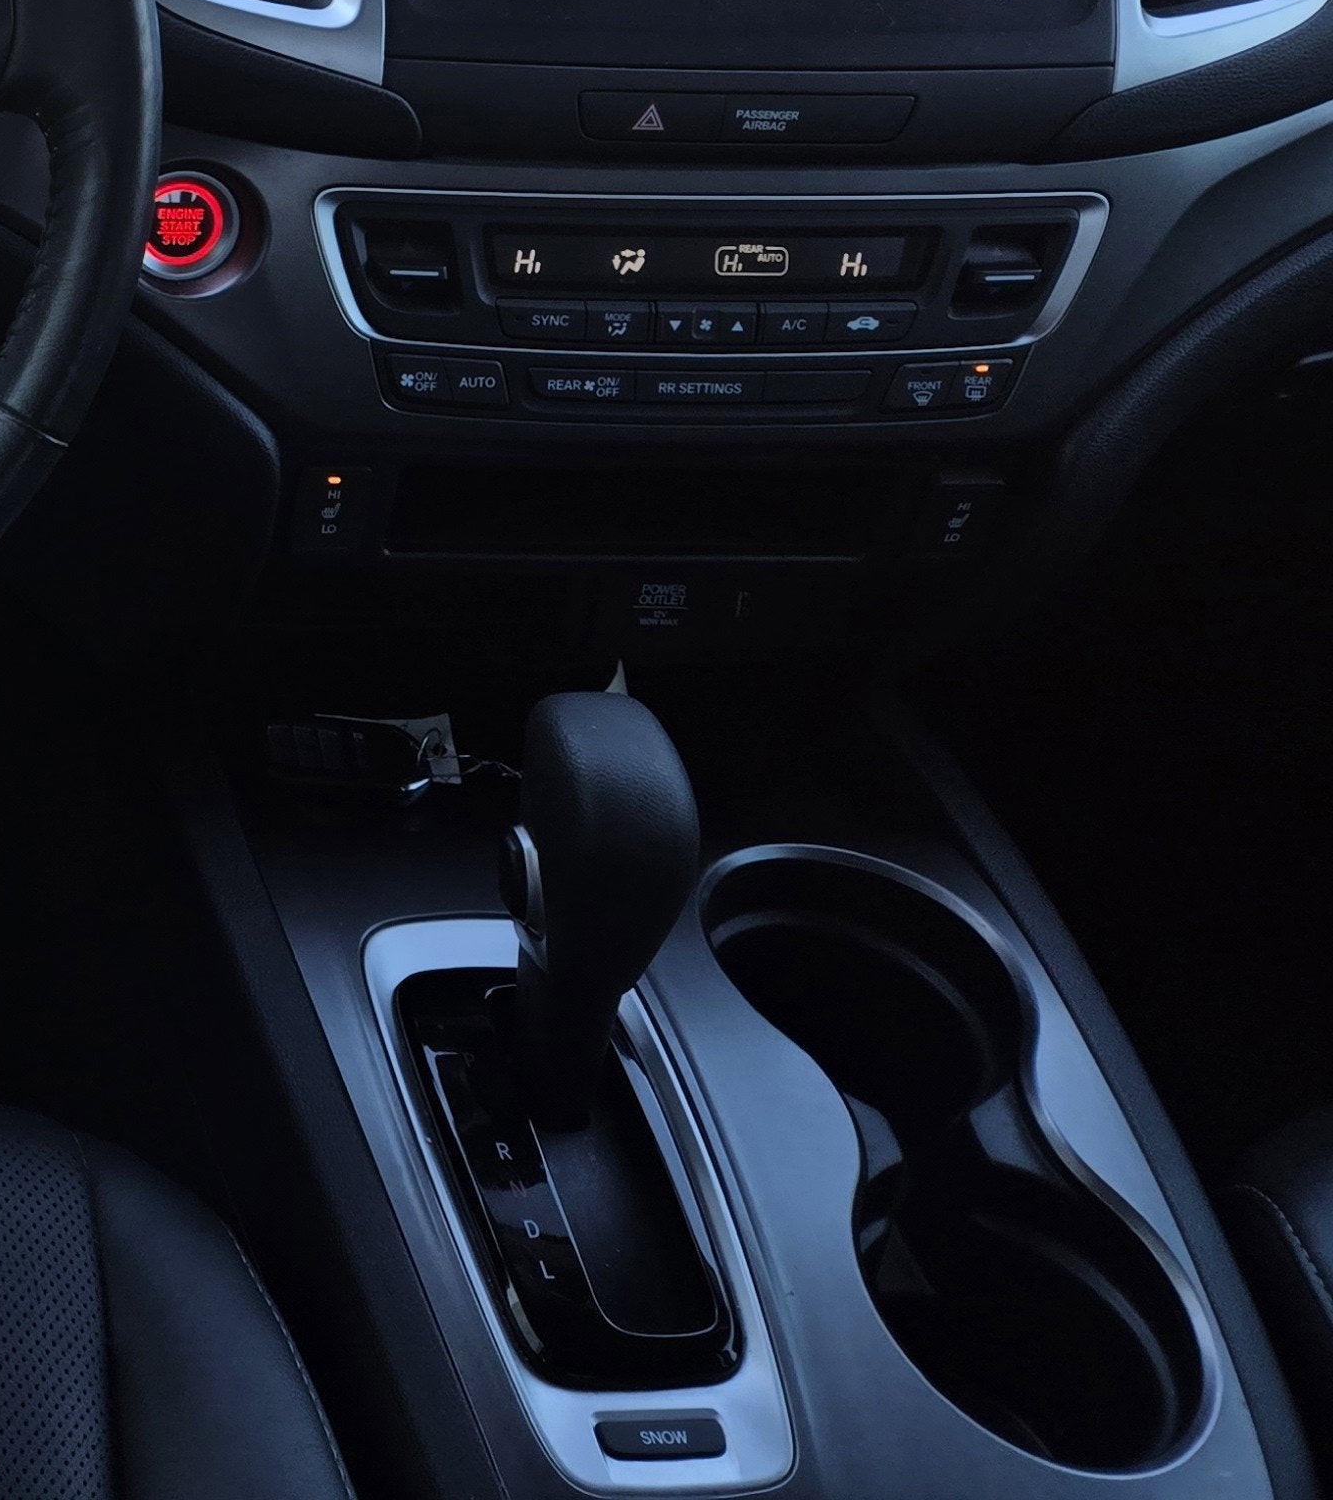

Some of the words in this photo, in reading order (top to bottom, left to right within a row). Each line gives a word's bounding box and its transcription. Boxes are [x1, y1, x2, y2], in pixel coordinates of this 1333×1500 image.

[735, 109, 800, 121] PASSENGER
[742, 120, 787, 131] AIRBAG
[157, 207, 205, 220] ENGINE
[159, 220, 201, 232] START
[161, 234, 197, 246] STOP
[738, 244, 764, 254] REAR
[757, 253, 784, 263] AUTO
[531, 314, 570, 327] SYNC
[604, 313, 631, 322] MODE
[782, 319, 807, 331] A/C
[414, 381, 438, 392] OFF
[459, 376, 497, 388] AUTO
[547, 379, 582, 391] REAR
[907, 380, 943, 391] FRONT
[964, 375, 993, 386] REAR
[595, 387, 620, 397] OFF
[658, 382, 676, 394] RR
[678, 383, 743, 394] SETTINGS
[327, 489, 342, 500] HI
[956, 502, 972, 512] HI
[321, 524, 337, 534] LO
[943, 532, 961, 542] LO
[641, 583, 687, 595] POWER
[638, 594, 687, 606] OUTLET
[494, 1141, 513, 1161] R
[523, 1218, 541, 1239] D
[539, 1259, 556, 1280] L
[638, 1429, 689, 1446] SNOW
